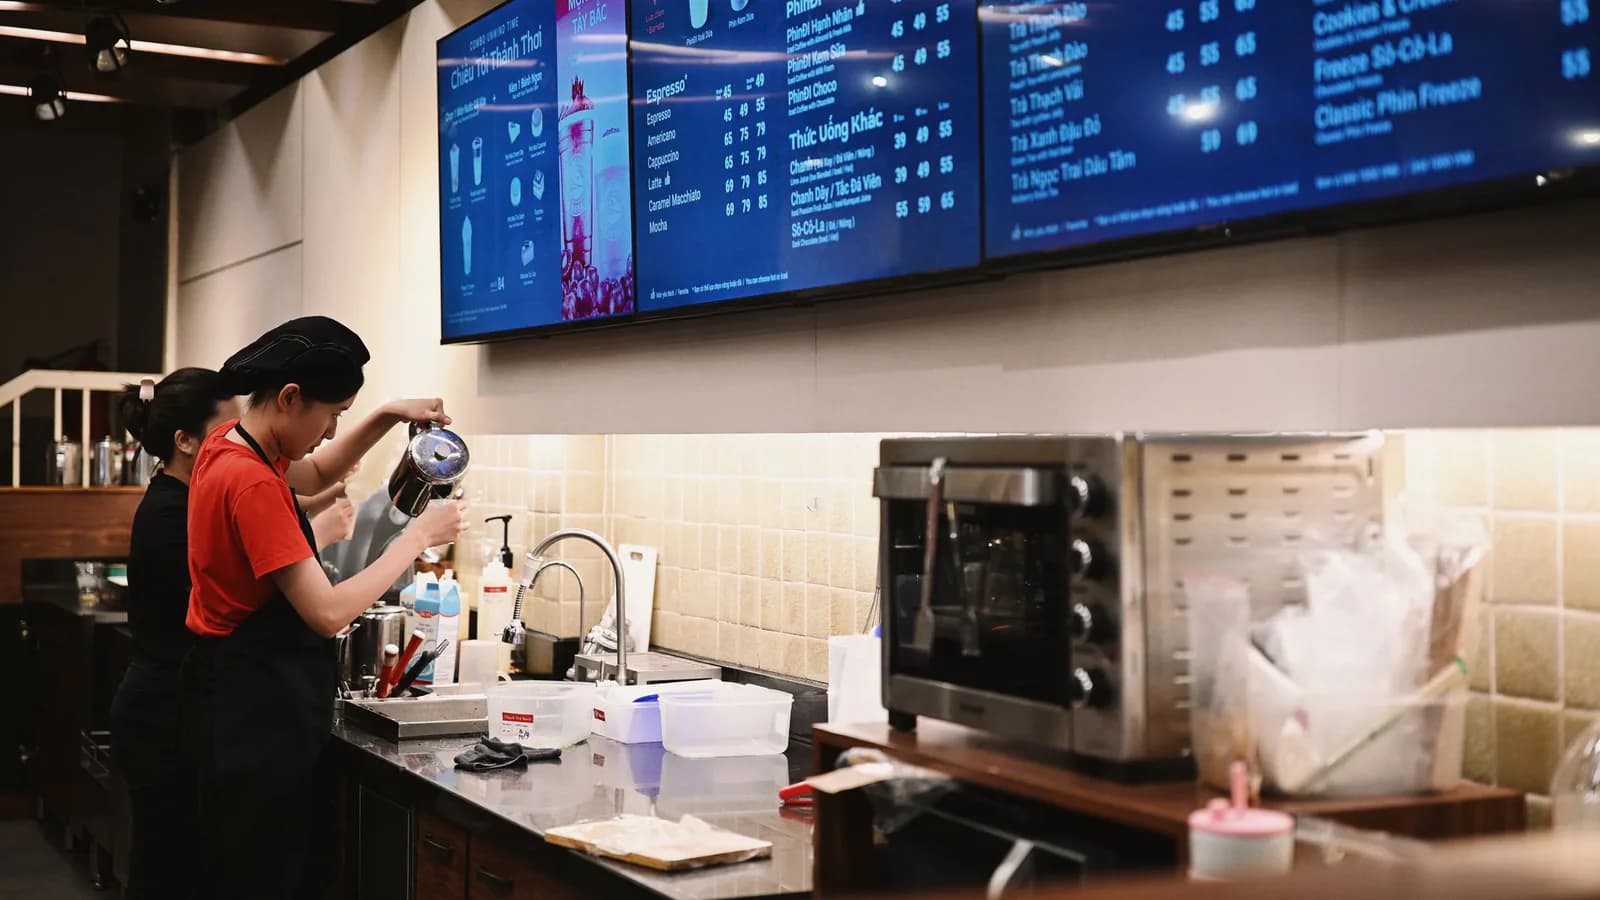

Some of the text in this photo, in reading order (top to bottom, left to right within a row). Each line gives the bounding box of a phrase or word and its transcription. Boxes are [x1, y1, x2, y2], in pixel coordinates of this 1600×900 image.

[506, 16, 519, 31] TIME
[891, 3, 949, 38] 45 49 55
[490, 38, 519, 70] Thảnh
[521, 25, 542, 55] Thơi
[811, 50, 829, 66] Kem
[891, 39, 950, 72] 45 49 55
[1009, 57, 1027, 78] Trà
[1028, 47, 1063, 72] Thh
[1166, 51, 1185, 74] 45
[755, 72, 765, 88] 49
[813, 79, 838, 98] Choco
[723, 84, 732, 99] 45
[724, 97, 765, 122] 45 49 55
[1010, 95, 1028, 115] Trà
[647, 108, 671, 126] Espresso
[819, 115, 849, 143] Uống
[851, 107, 884, 134] Khác
[647, 129, 676, 147] Americano
[724, 121, 766, 146] 65 75 79
[894, 119, 953, 150] 39 49 55
[1011, 133, 1028, 153] Trà
[1030, 126, 1058, 148] Xanh
[648, 150, 679, 169] Cappuccino
[724, 146, 766, 169] 65 75 79
[917, 161, 930, 179] 49
[940, 155, 953, 174] 55
[648, 176, 662, 190] Latte
[725, 170, 767, 193] 69 79 85
[1011, 170, 1029, 190] Trà
[649, 188, 701, 212] Caramel Macchiato
[726, 194, 767, 216] 69 79 85
[791, 187, 814, 206] Chanh
[896, 200, 908, 218] 55
[649, 218, 667, 234] Mocha
